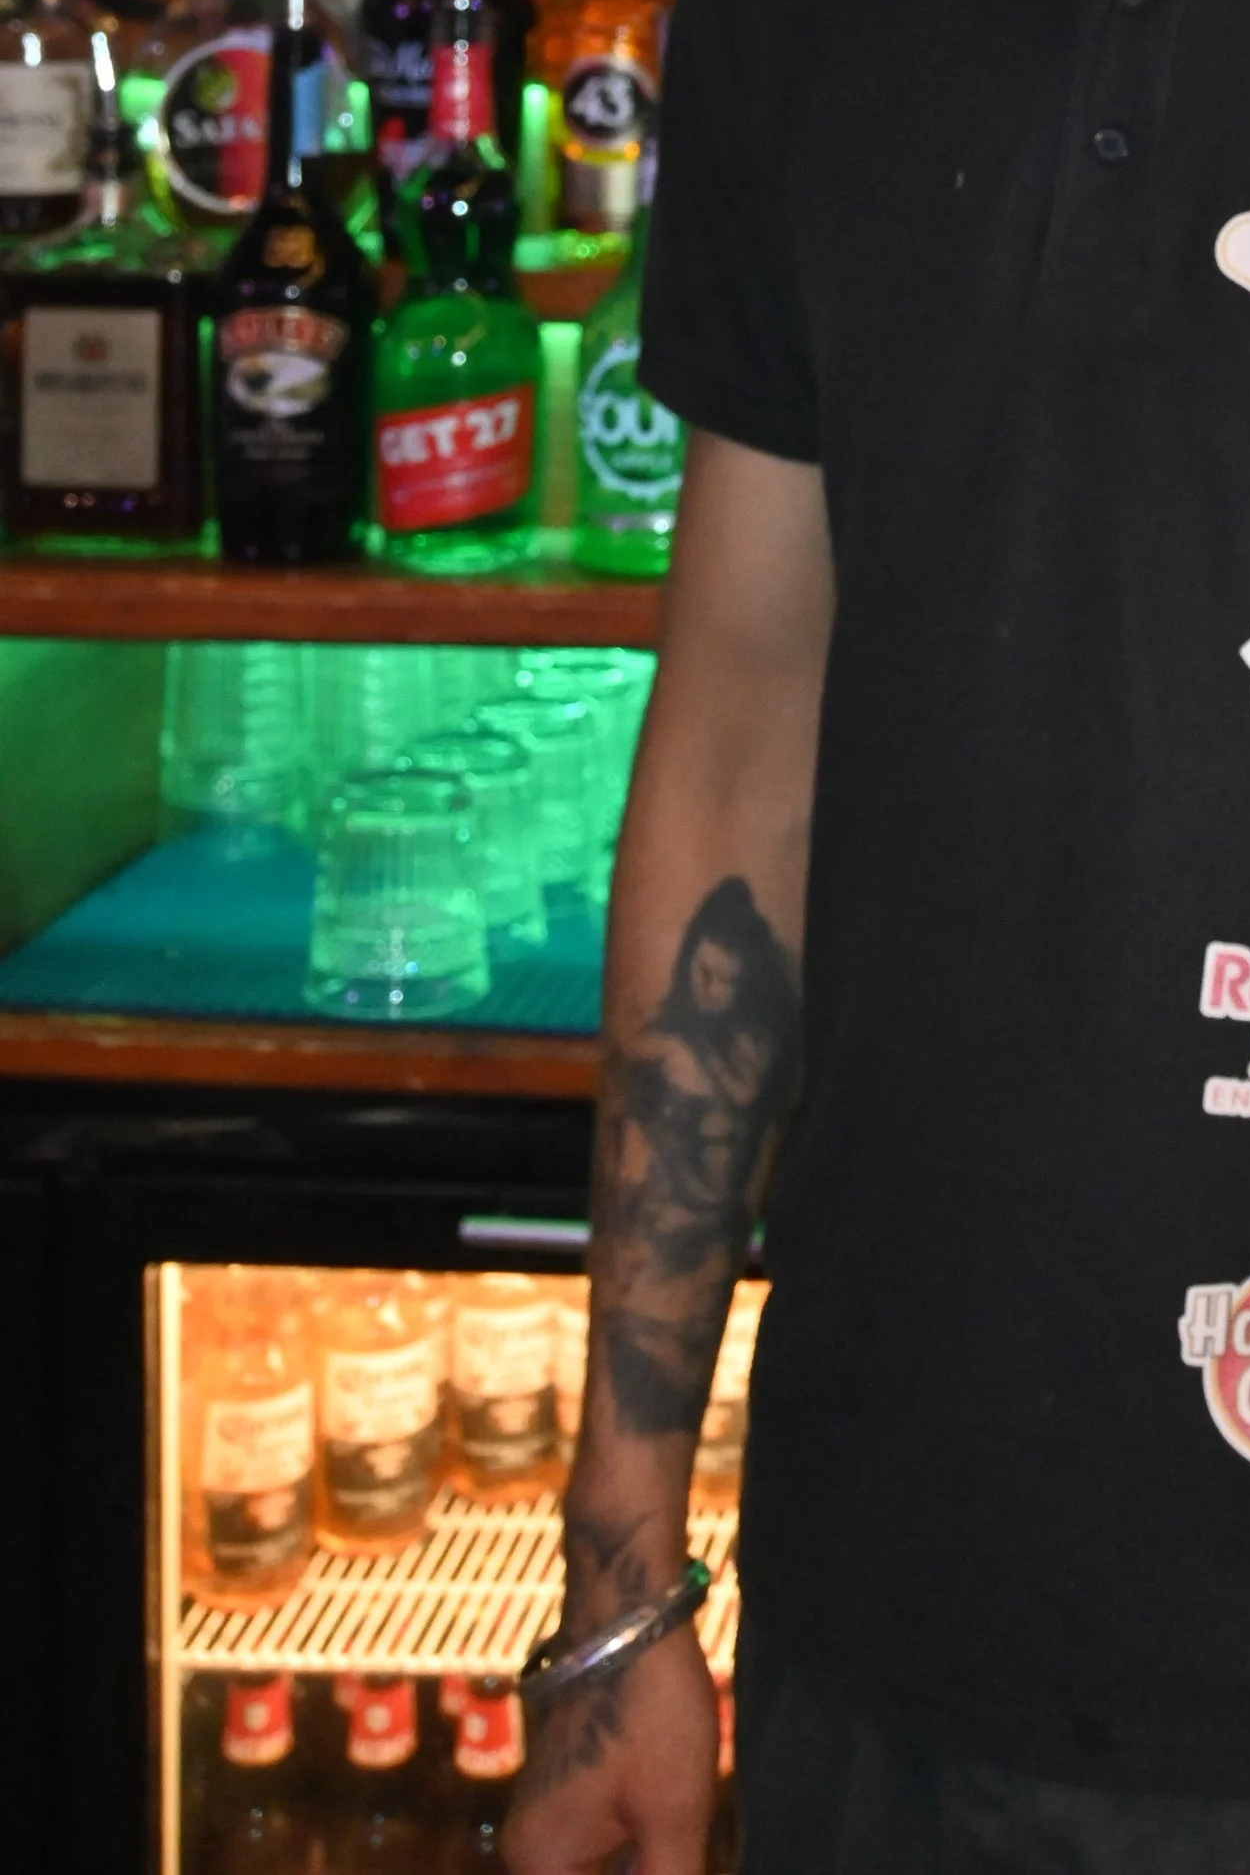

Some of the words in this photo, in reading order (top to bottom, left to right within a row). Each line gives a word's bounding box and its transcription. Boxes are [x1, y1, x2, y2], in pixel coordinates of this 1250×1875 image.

[568, 71, 635, 134] 43
[379, 415, 459, 467] GET
[464, 398, 521, 451] 27
